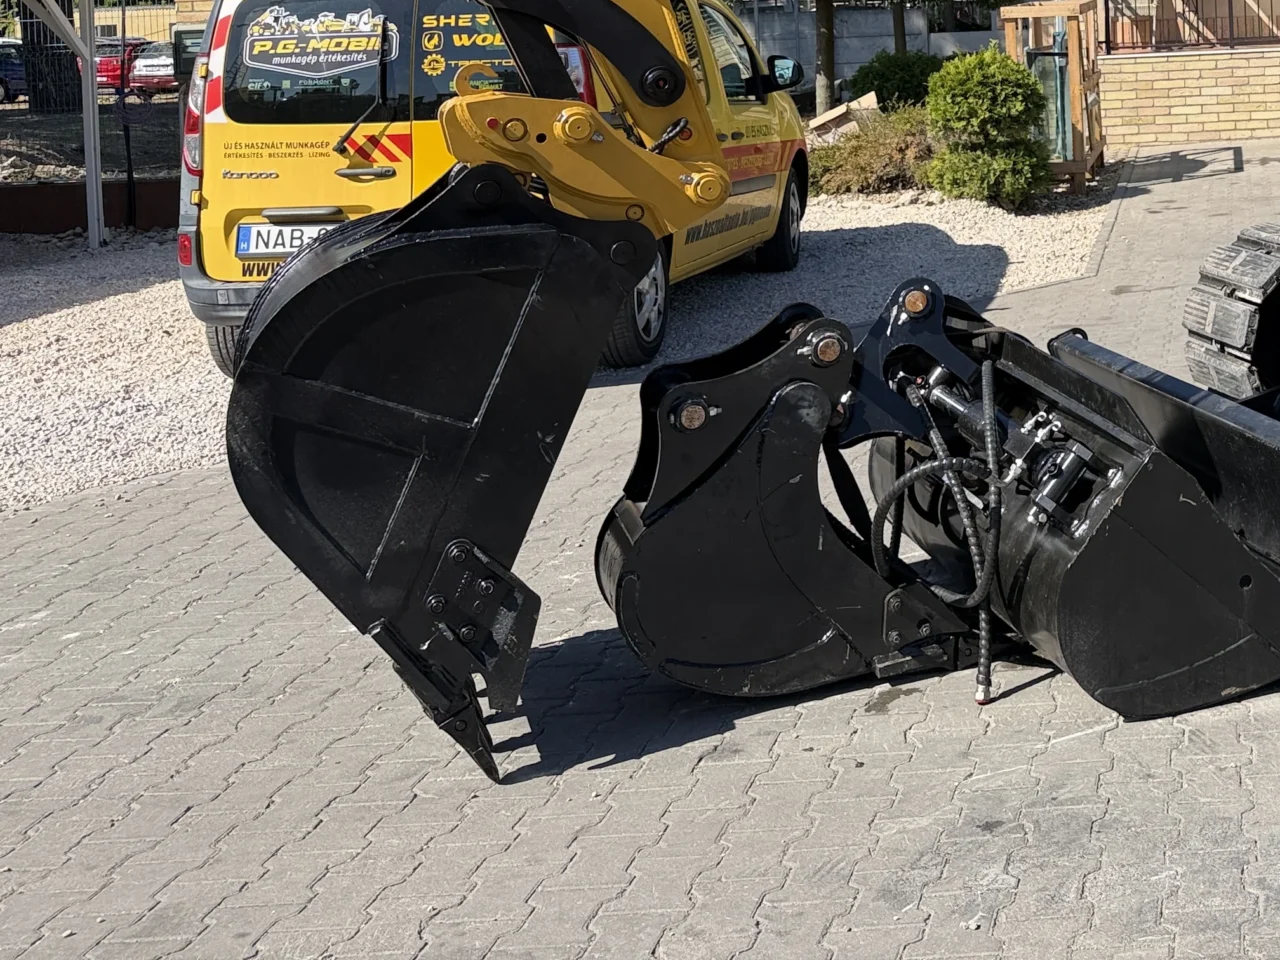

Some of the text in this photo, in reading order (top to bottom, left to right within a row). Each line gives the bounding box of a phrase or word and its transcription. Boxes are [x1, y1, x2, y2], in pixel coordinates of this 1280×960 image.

[272, 51, 367, 66] munkagép értékesítés
[223, 140, 330, 150] ÚJ ÉS HASZNÁLT MUNKAGÉP
[223, 151, 264, 159] ÉRTÉKESÍTÉS
[268, 151, 304, 159] BESZERZÉS
[240, 242, 248, 250] H
